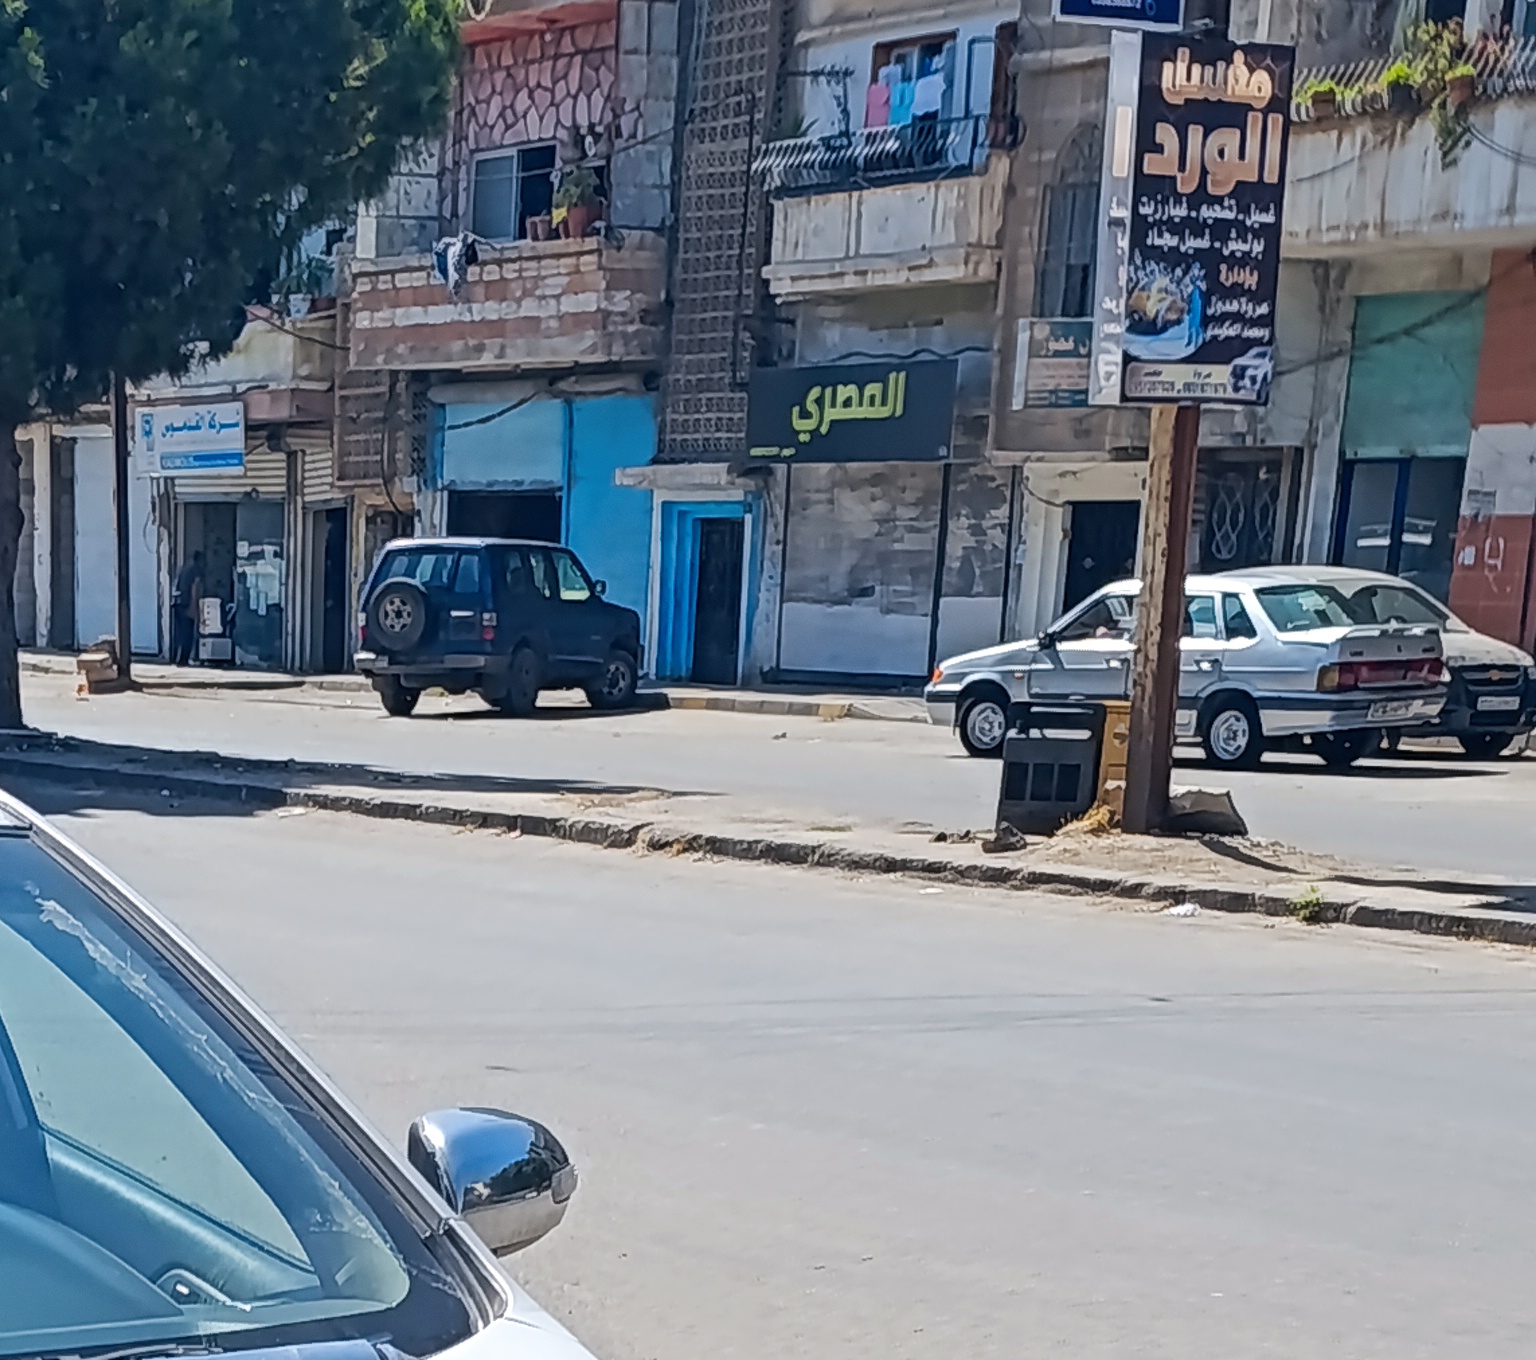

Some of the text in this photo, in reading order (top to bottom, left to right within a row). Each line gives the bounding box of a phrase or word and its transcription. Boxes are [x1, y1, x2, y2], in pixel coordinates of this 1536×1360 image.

[1162, 46, 1272, 109] مغسل
[1143, 111, 1283, 196] الورد
[1199, 195, 1237, 224] تشحيم
[1245, 202, 1276, 229] غسيل
[1179, 228, 1212, 254] غسيل
[1222, 227, 1265, 260] بوليش
[207, 408, 240, 435] شركة
[791, 370, 907, 443] المصري
